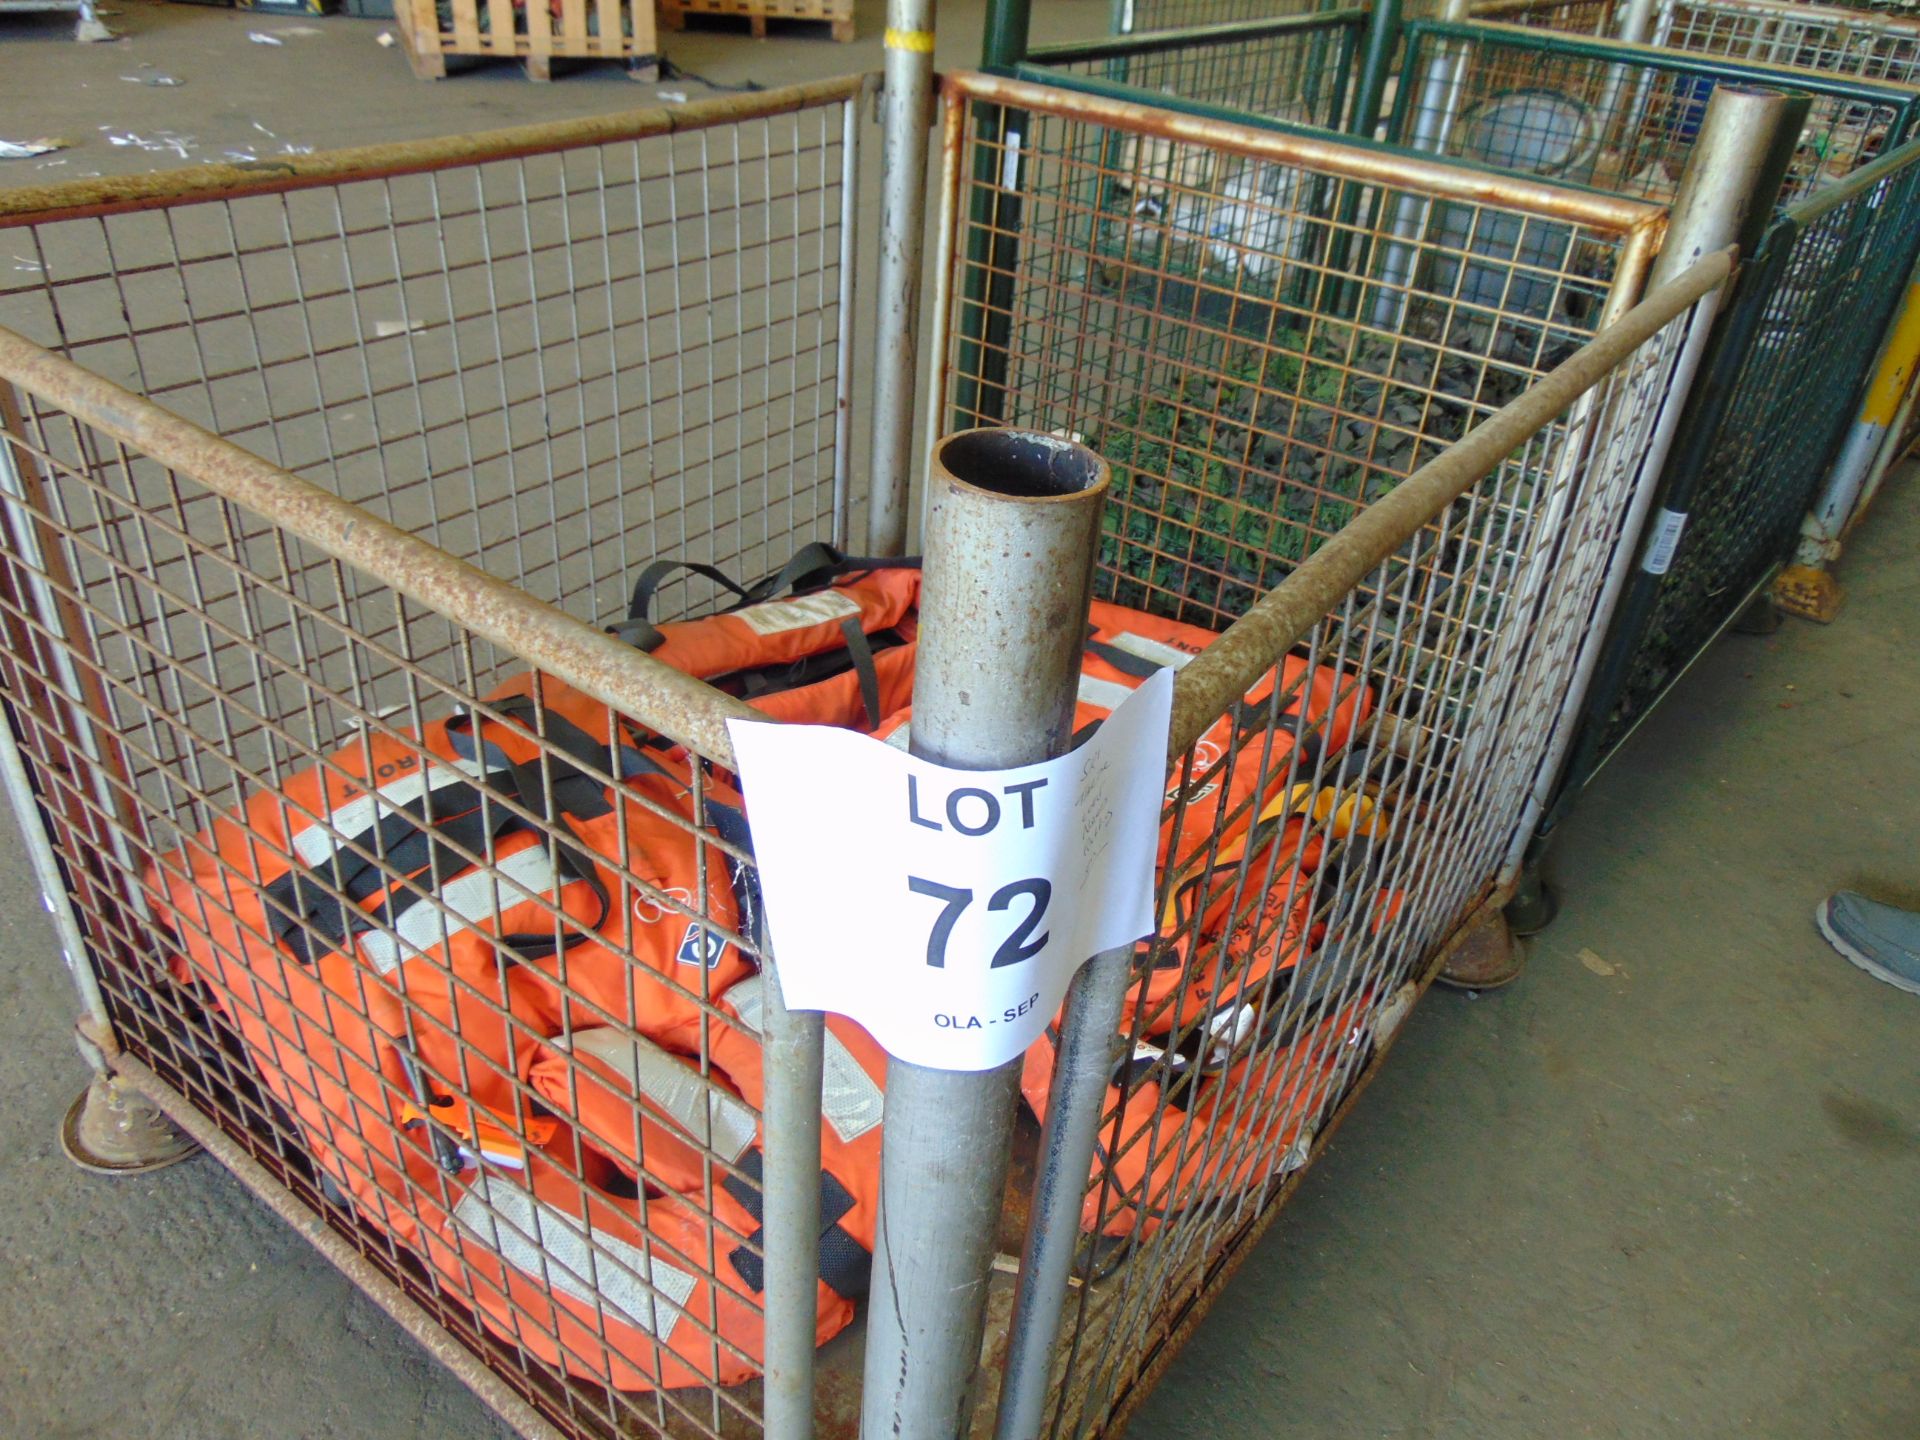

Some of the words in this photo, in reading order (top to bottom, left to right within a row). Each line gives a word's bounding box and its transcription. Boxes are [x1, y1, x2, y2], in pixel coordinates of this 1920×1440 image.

[343, 755, 417, 798] ROT
[907, 773, 1049, 837] LOT
[907, 875, 1052, 969] 72
[933, 1013, 982, 1030] OLA
[1003, 992, 1040, 1024] SEP
